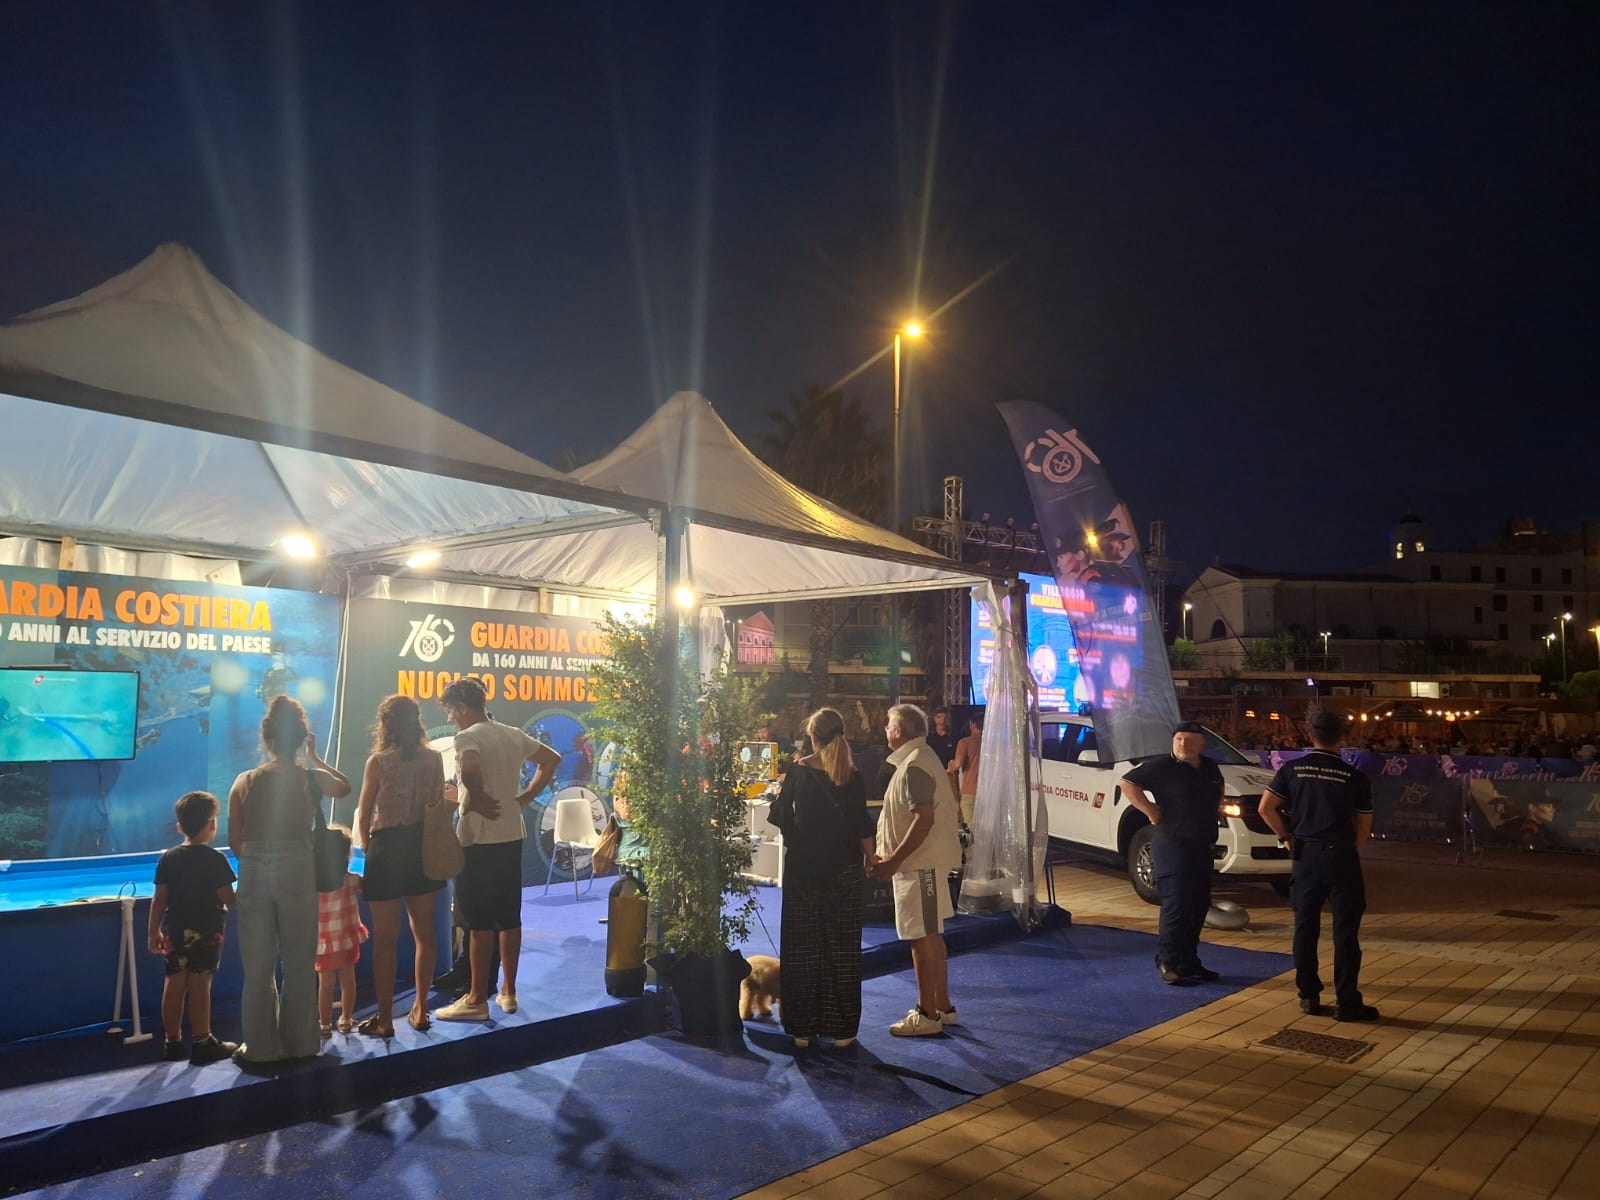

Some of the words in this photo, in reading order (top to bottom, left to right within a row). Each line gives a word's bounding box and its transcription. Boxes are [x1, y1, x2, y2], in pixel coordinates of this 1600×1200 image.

[115, 590, 272, 631] COSTIERA
[8, 623, 61, 643] ANNI
[66, 626, 90, 645] AL
[96, 628, 181, 649] SERVIZIO
[186, 633, 216, 651] DEL
[222, 635, 272, 653] PAESE
[470, 621, 570, 653] GUARDIA
[472, 653, 489, 668] DA
[494, 654, 516, 669] 160
[519, 656, 547, 670] ANNI
[551, 657, 564, 671] AL
[398, 670, 496, 701] NUCO
[1055, 787, 1089, 803] COSTIERA
